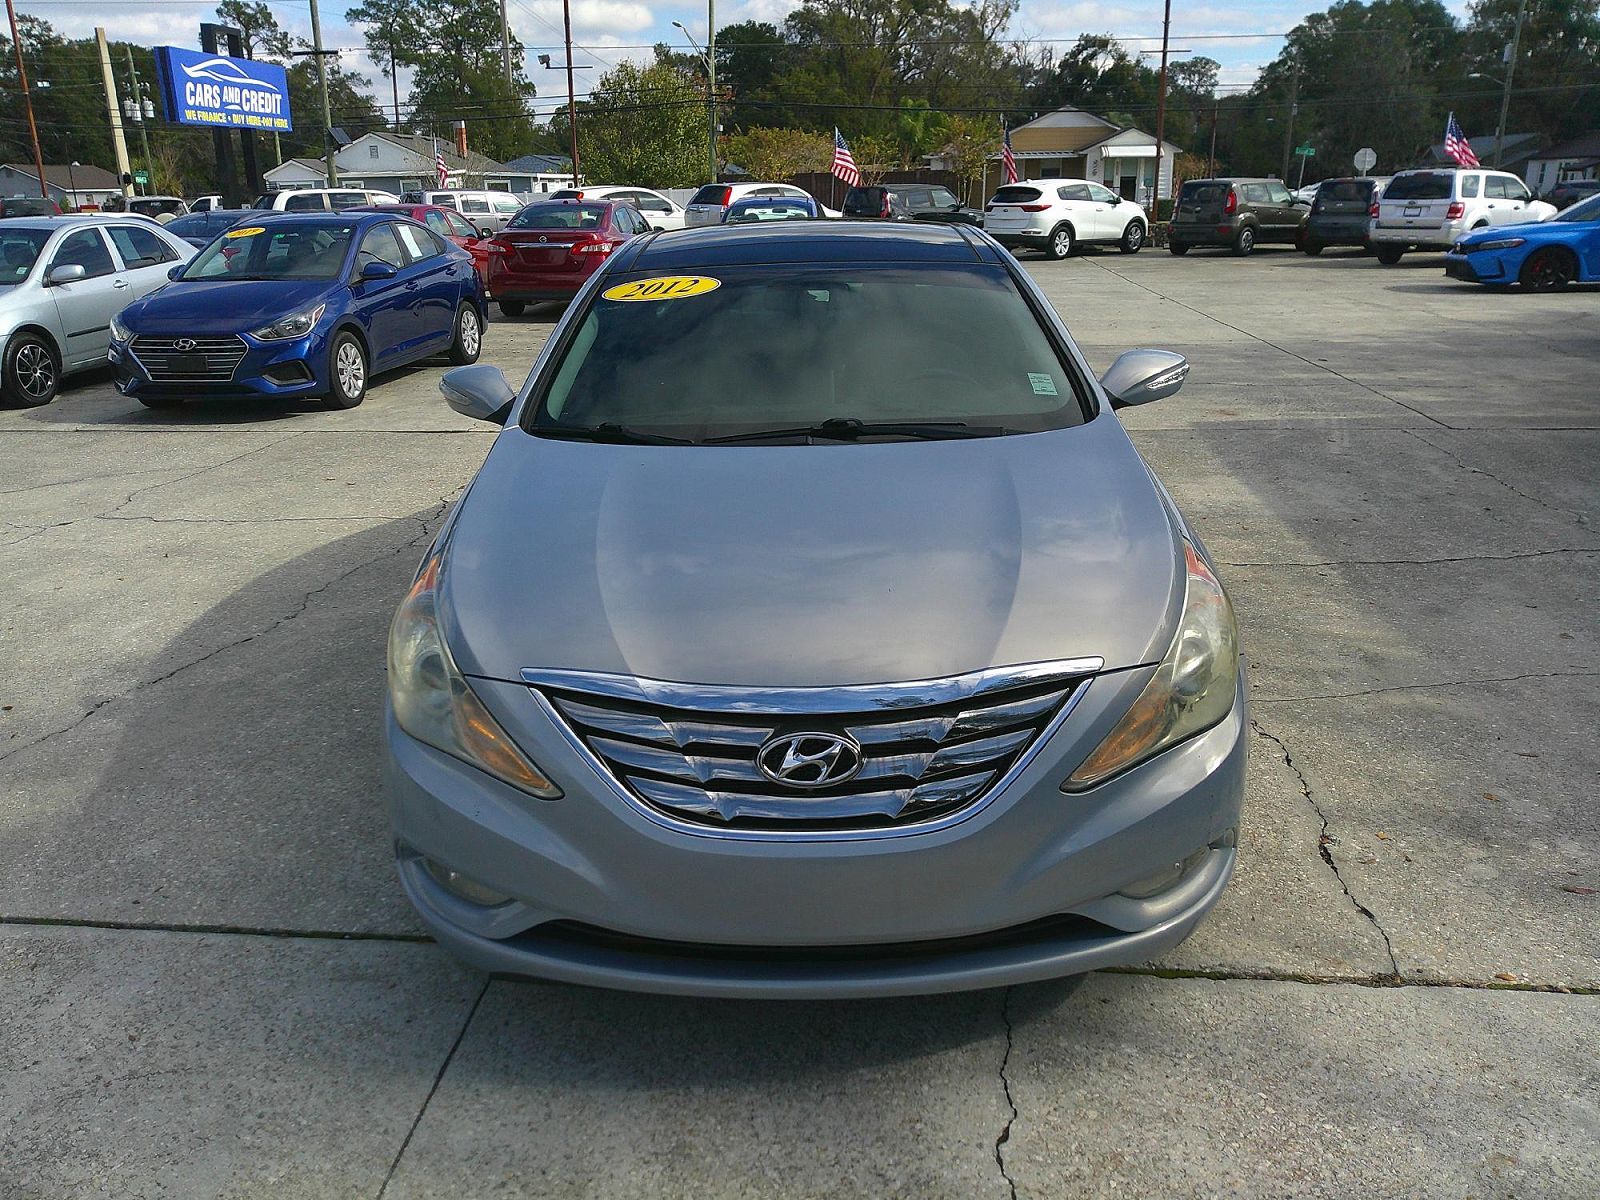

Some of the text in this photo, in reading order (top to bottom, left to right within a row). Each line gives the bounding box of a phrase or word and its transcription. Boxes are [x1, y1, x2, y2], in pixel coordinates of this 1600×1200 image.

[185, 81, 282, 115] CARS AND CREDIT
[185, 109, 197, 120] WE
[197, 110, 227, 124] FINANCE
[231, 113, 245, 125] BUY
[621, 279, 700, 298] 2012
